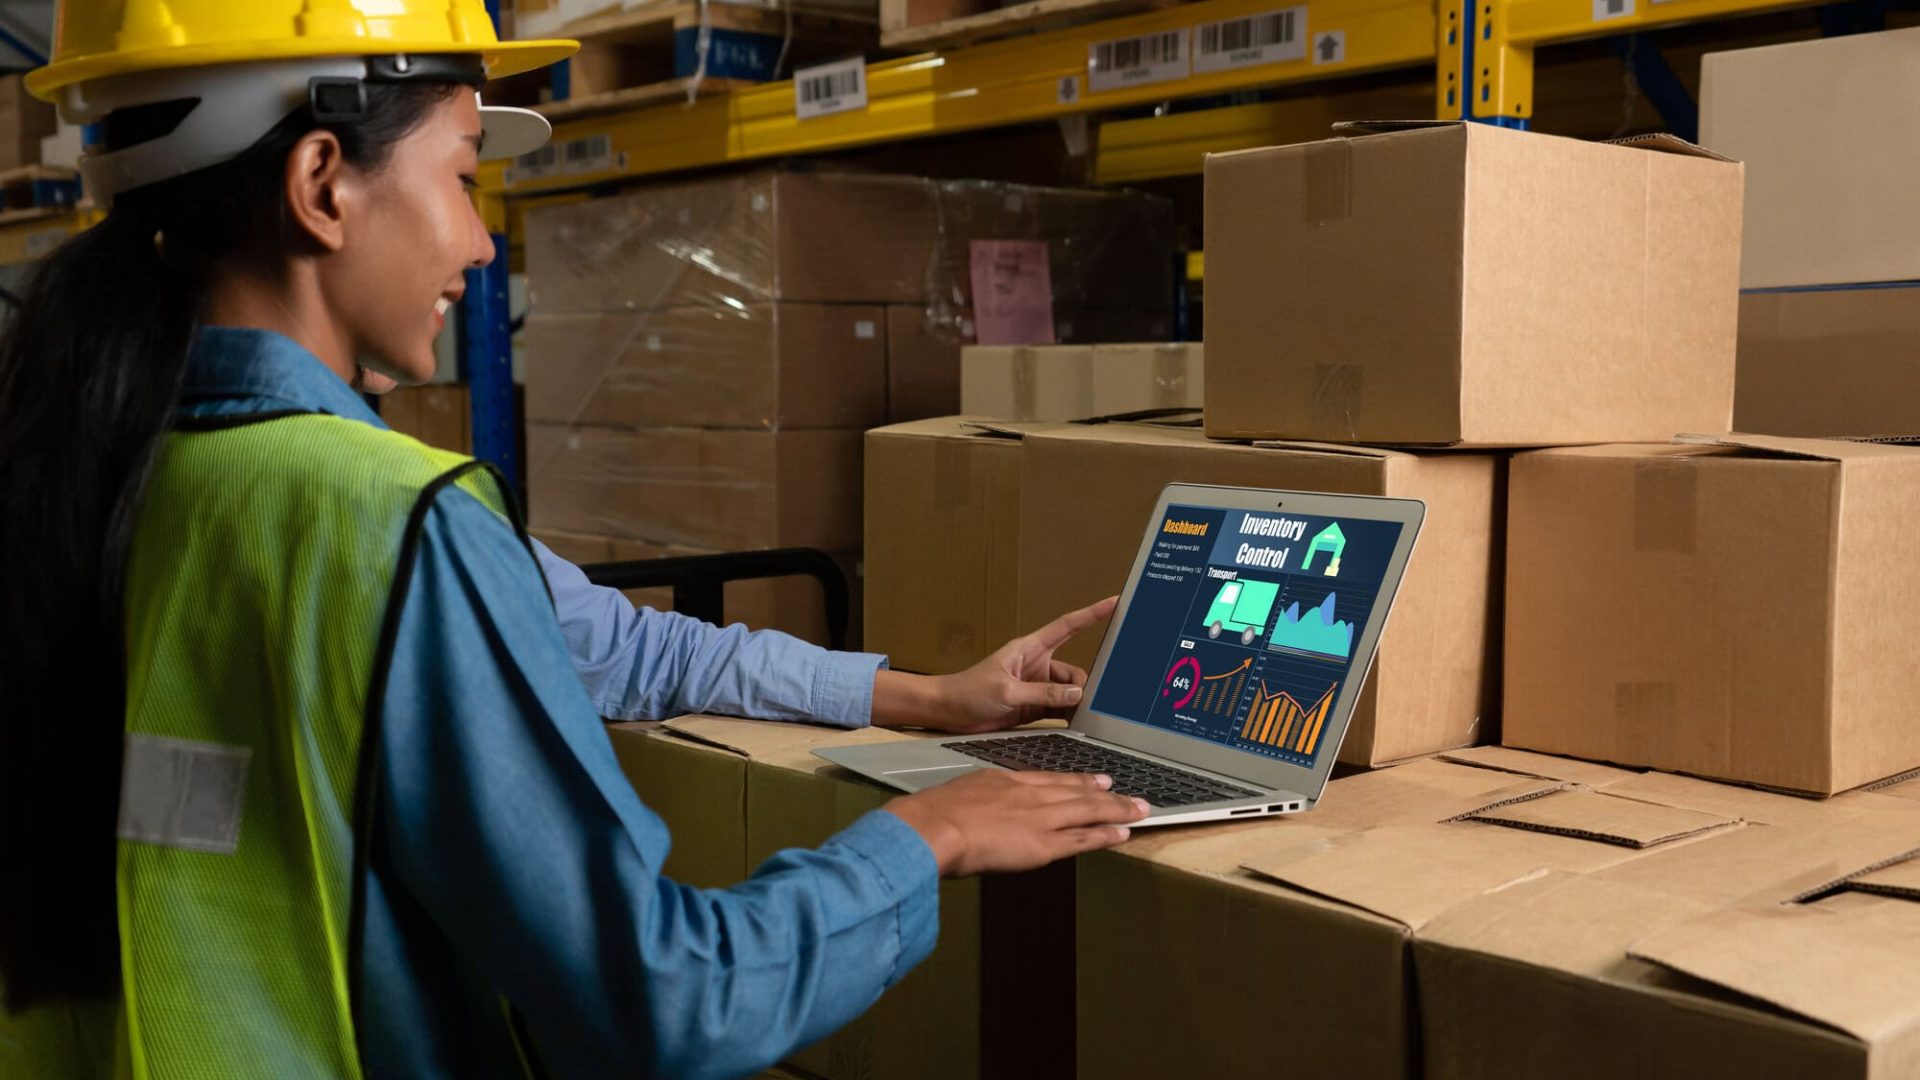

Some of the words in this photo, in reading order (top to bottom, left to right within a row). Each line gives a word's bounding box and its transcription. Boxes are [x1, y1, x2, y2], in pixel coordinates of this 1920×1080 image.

[1163, 519, 1209, 536] Dashboard
[1239, 513, 1307, 541] Inventory
[1235, 542, 1290, 569] Control
[1207, 566, 1238, 581] Transport
[1173, 676, 1190, 690] 64%
